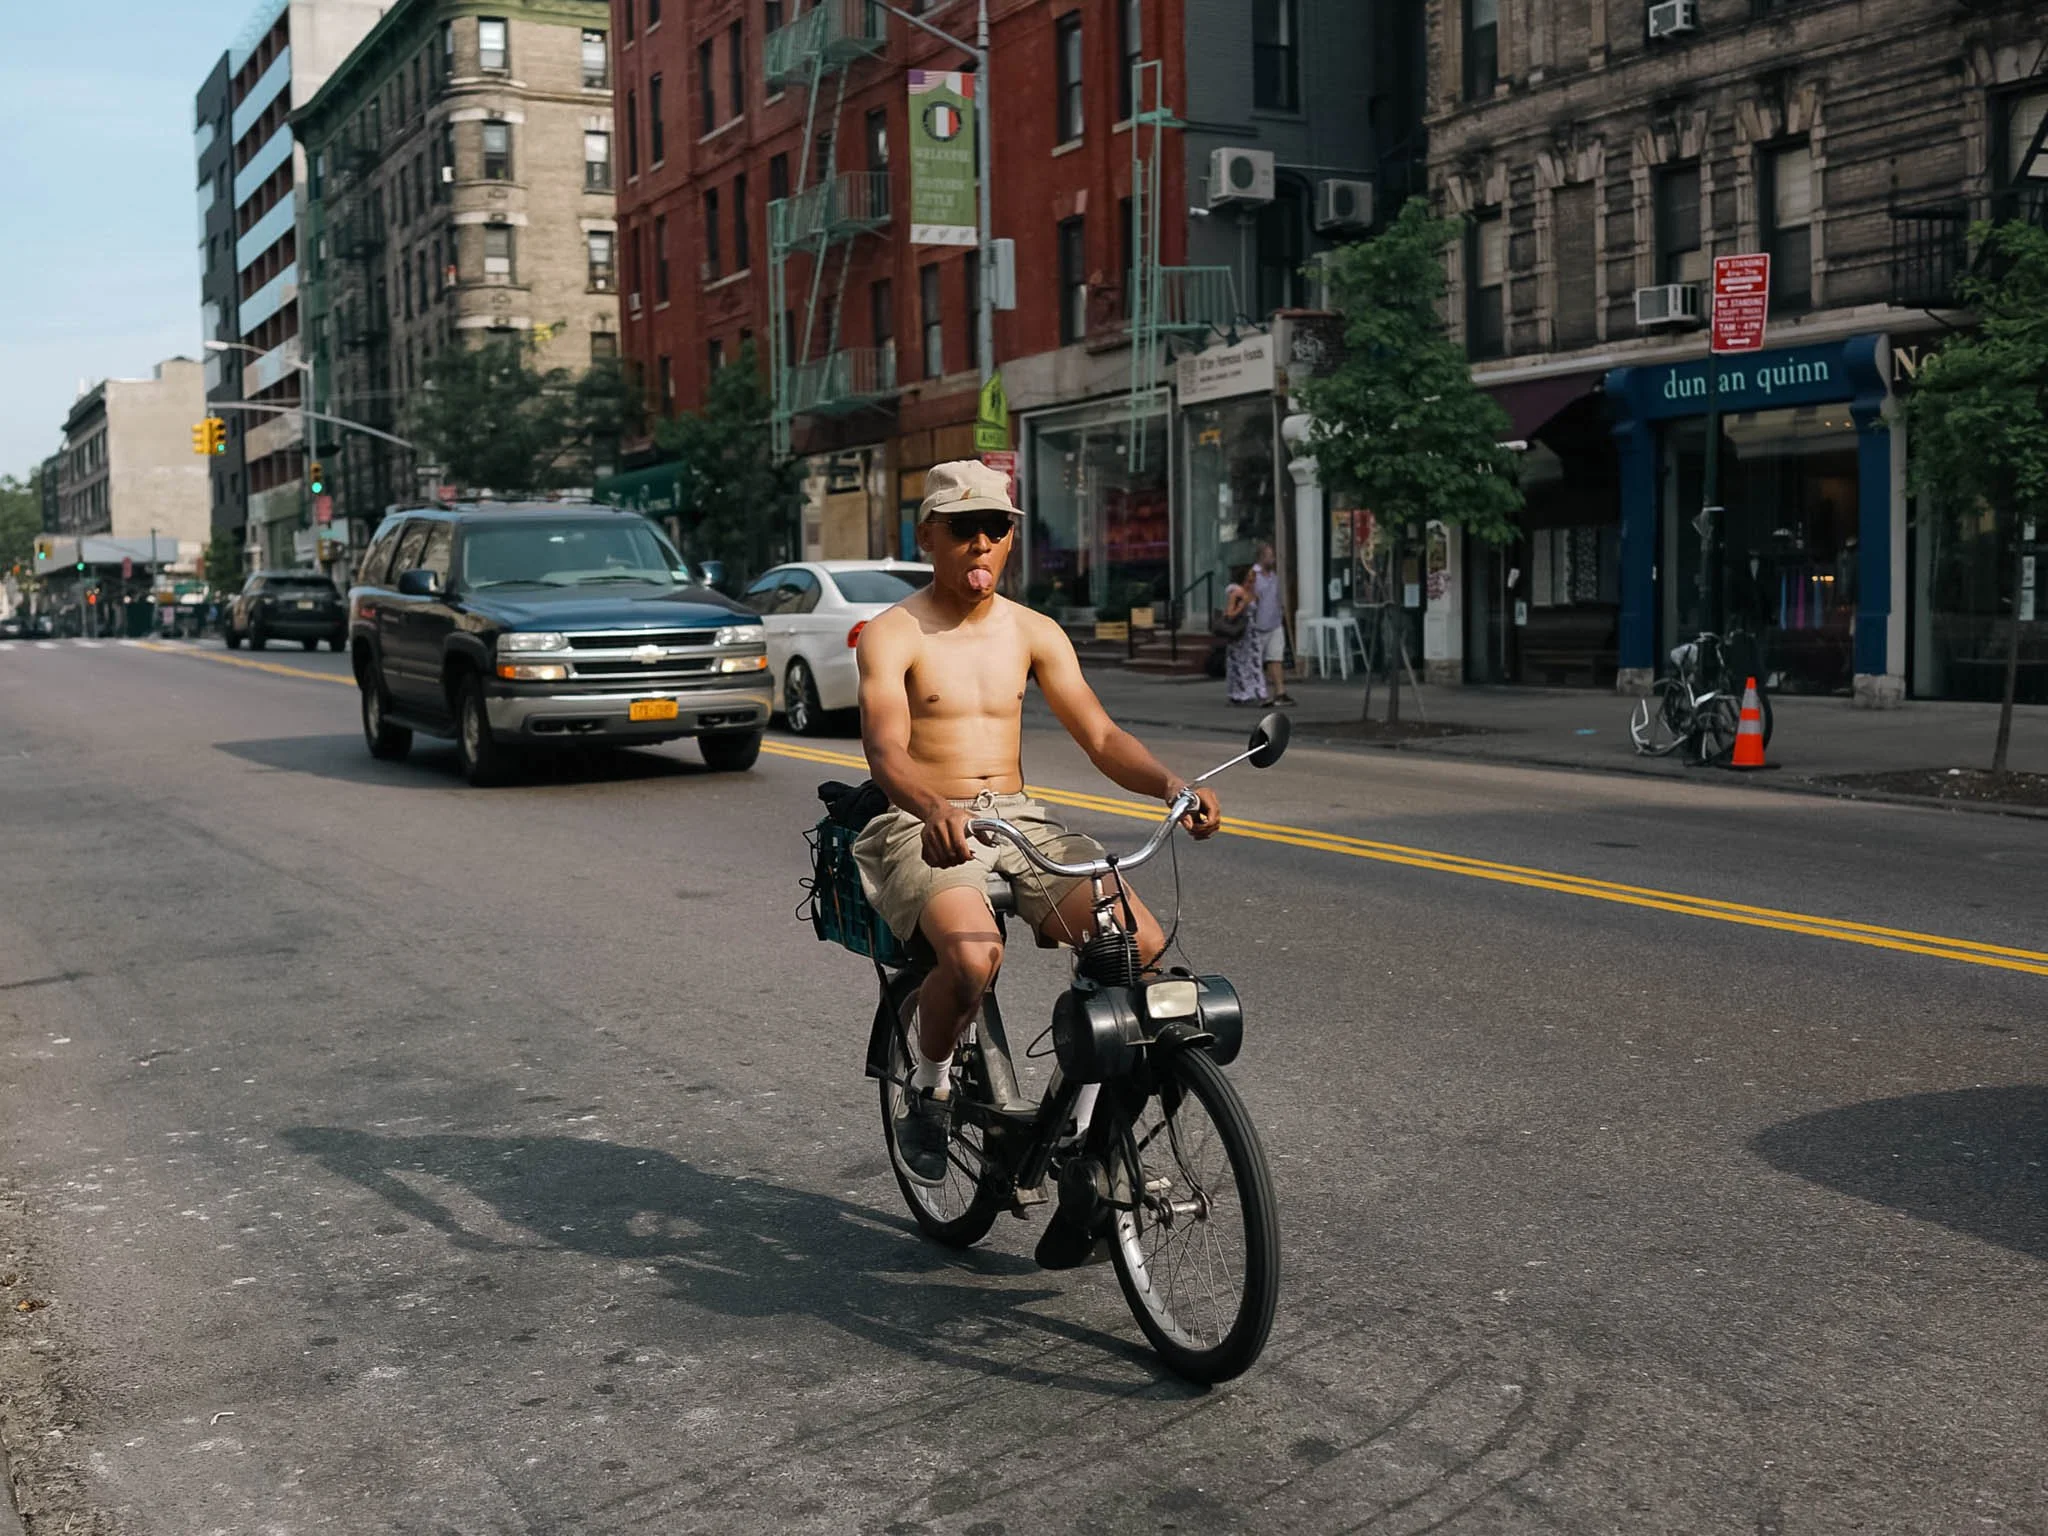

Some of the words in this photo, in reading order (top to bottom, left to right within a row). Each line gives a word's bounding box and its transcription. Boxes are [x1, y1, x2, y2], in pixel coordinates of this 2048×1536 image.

[1717, 300, 1728, 308] NO
[1730, 297, 1763, 307] STANDING
[1664, 369, 1746, 399] dunan
[1756, 357, 1830, 394] quinn
